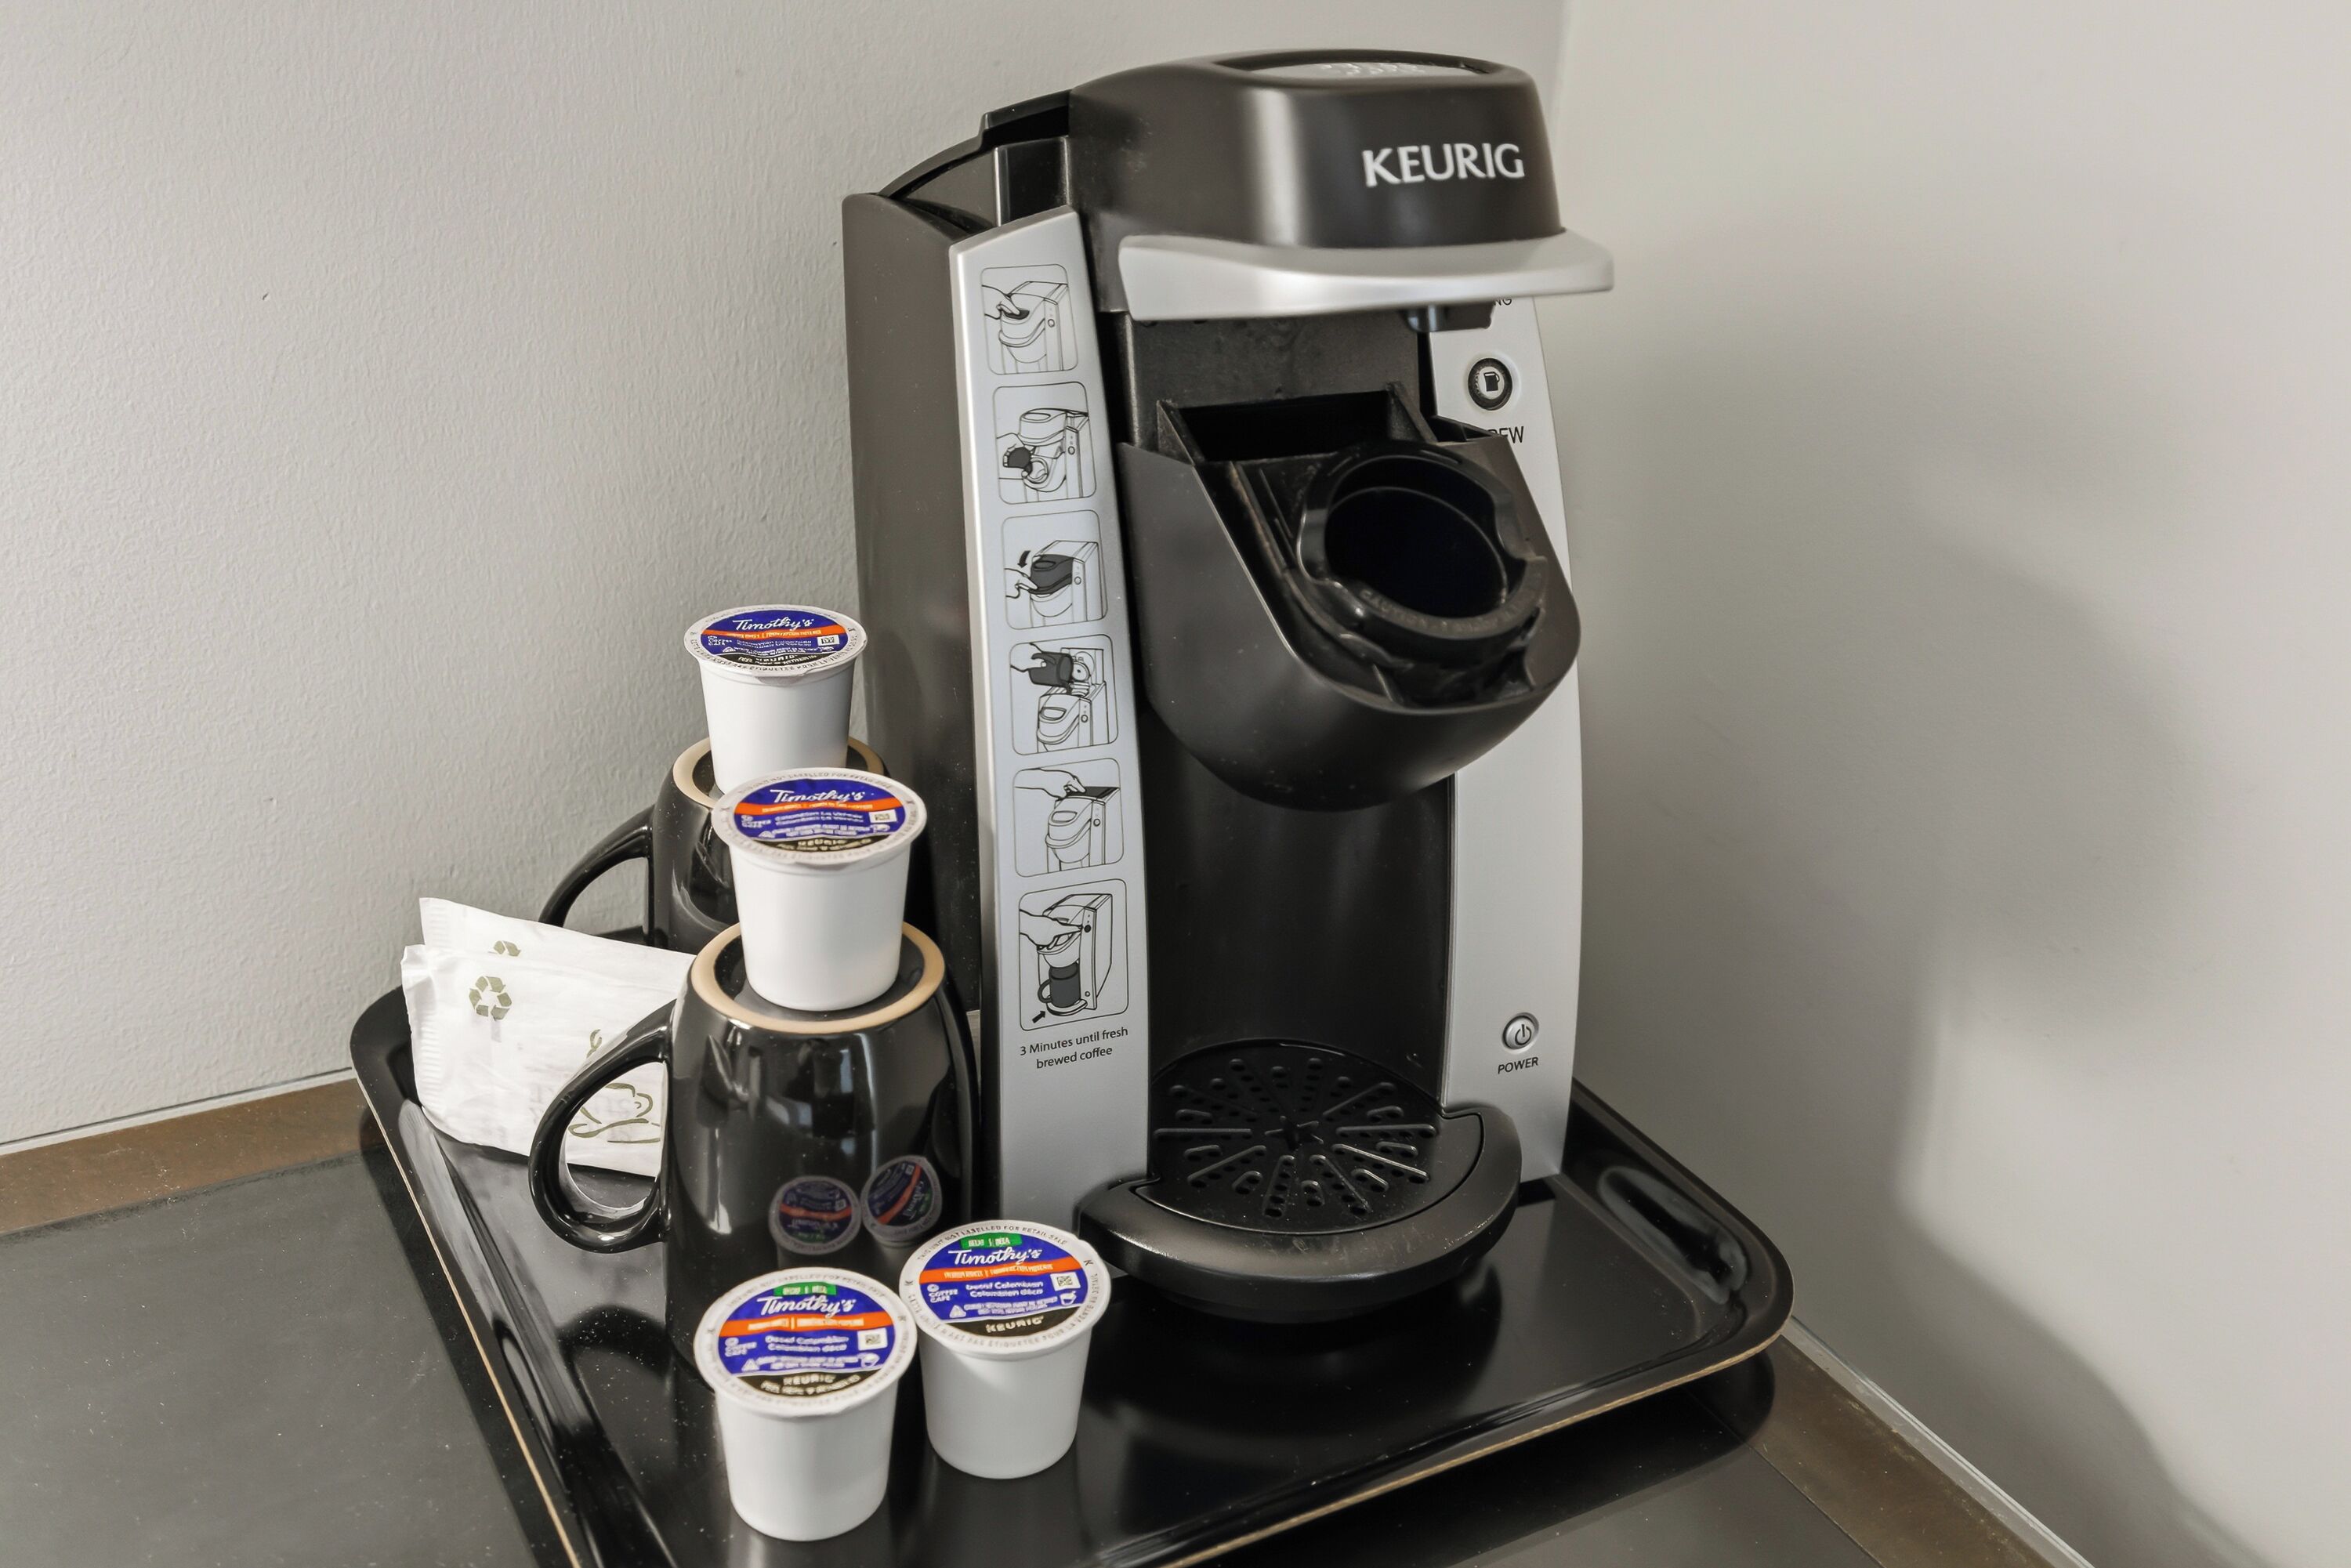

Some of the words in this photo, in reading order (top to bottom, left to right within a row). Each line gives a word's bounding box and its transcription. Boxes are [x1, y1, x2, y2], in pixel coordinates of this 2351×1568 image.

[1362, 143, 1525, 187] KEURIG
[733, 617, 813, 632] Timothy's
[770, 789, 866, 803] Timothy's
[1020, 1046, 1027, 1056] 3
[1029, 1039, 1073, 1054] Minutes
[1075, 1031, 1099, 1045] until
[1102, 1027, 1128, 1040] fresh
[1036, 1052, 1078, 1069] brewed
[1079, 1047, 1113, 1060] coffee
[1498, 1057, 1539, 1074] POWER
[947, 1247, 1043, 1266] Timothy's
[756, 1295, 857, 1318] Timothy's
